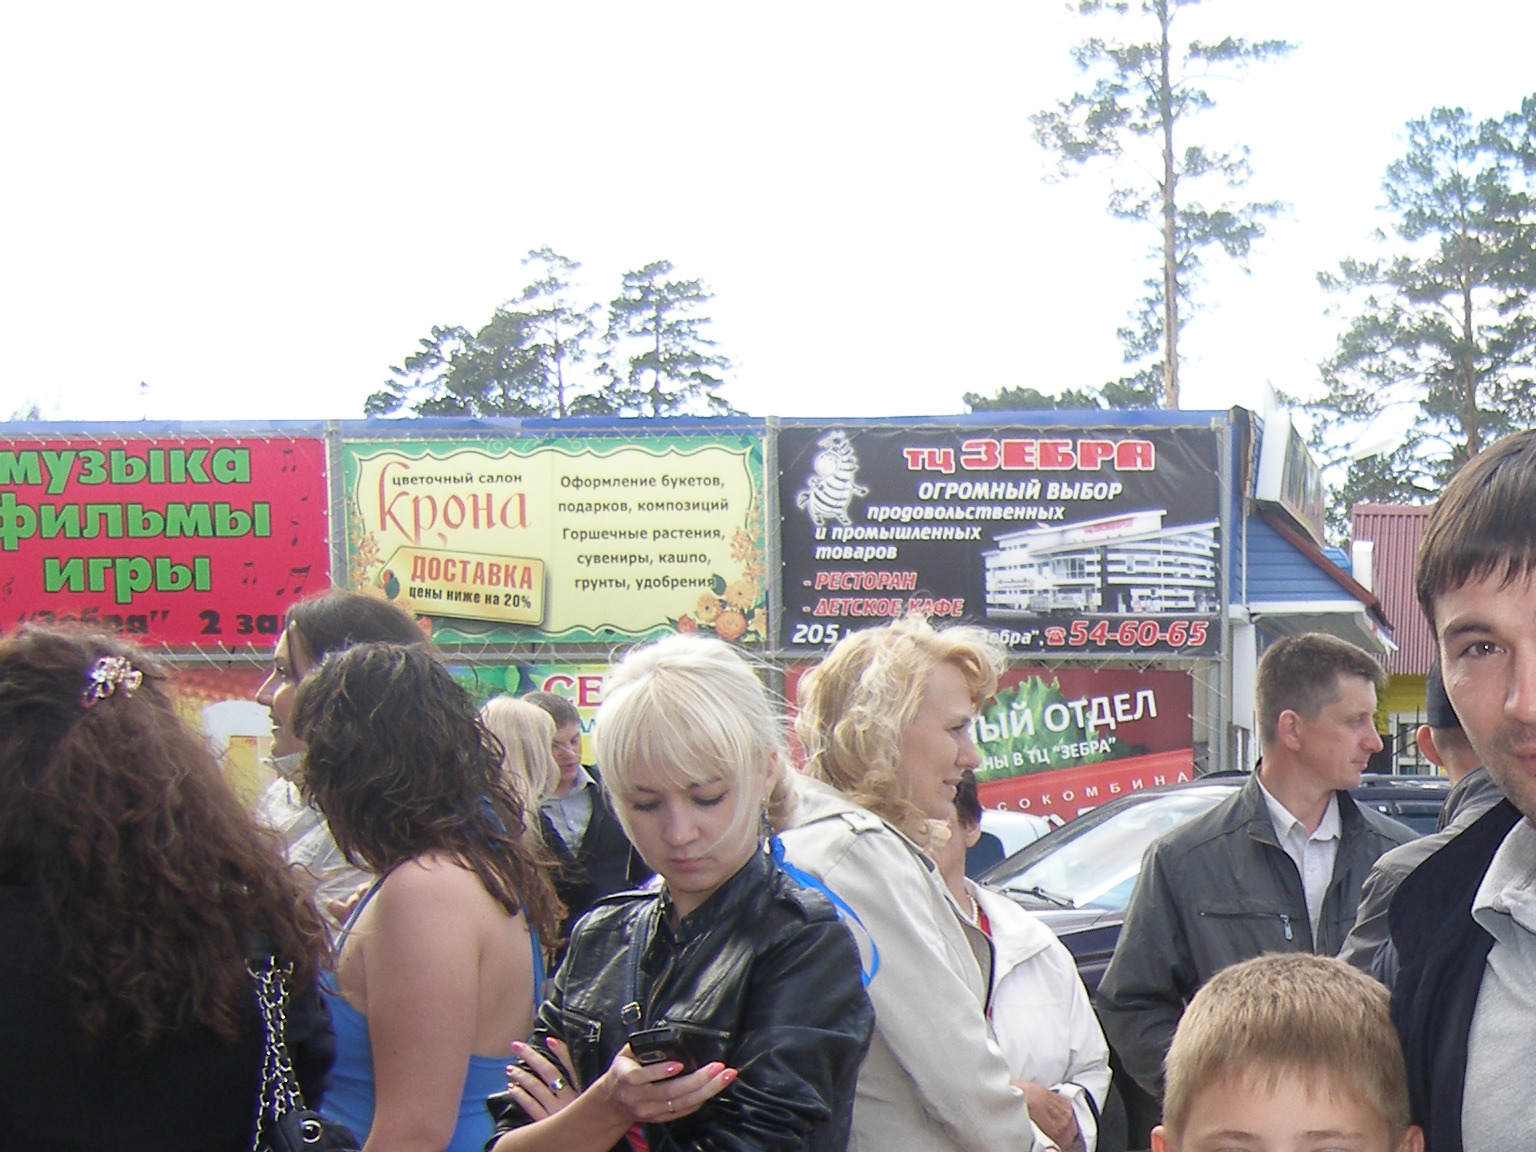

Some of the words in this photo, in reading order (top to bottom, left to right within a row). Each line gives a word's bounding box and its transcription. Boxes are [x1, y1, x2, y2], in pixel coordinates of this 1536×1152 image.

[959, 438, 1156, 471] ЗЕБРА
[0, 446, 251, 495] музыка
[392, 472, 474, 486] цветочный
[478, 473, 523, 484] салон
[560, 475, 657, 490] Оформление
[661, 474, 725, 489] букетов,
[918, 478, 1042, 500] ОГРОМНЫЙ
[1046, 482, 1123, 500] ВЫБОР
[558, 501, 632, 514] подарков,
[638, 498, 729, 513] композиций
[866, 505, 1066, 523] продовольственных
[0, 492, 271, 552] фильмы
[562, 528, 648, 543] Горшечные
[652, 528, 726, 542] растения,
[815, 526, 827, 541] и
[831, 525, 982, 542] промышленных
[577, 553, 654, 567] сувениры,
[658, 552, 712, 565] кашпо,
[814, 545, 898, 562] товаров
[43, 555, 212, 605] игры
[411, 555, 533, 591] ДОСТАВКА
[814, 571, 918, 590] РЕСТОРАН
[575, 578, 631, 592] грунты,
[635, 575, 716, 591] удобрения
[409, 586, 442, 599] цены
[446, 590, 481, 604] ниже
[484, 594, 500, 606] на
[504, 593, 532, 609] 20%
[813, 598, 903, 616] ДЕТСКОЕ
[907, 598, 966, 617] КАФЕ
[199, 610, 222, 635] 2
[792, 623, 840, 644] 205
[1068, 619, 1210, 647] 54-60-65
[1043, 689, 1158, 733] ОТДЕЛ
[1012, 751, 1024, 767] В
[1027, 748, 1051, 766] ТЦ
